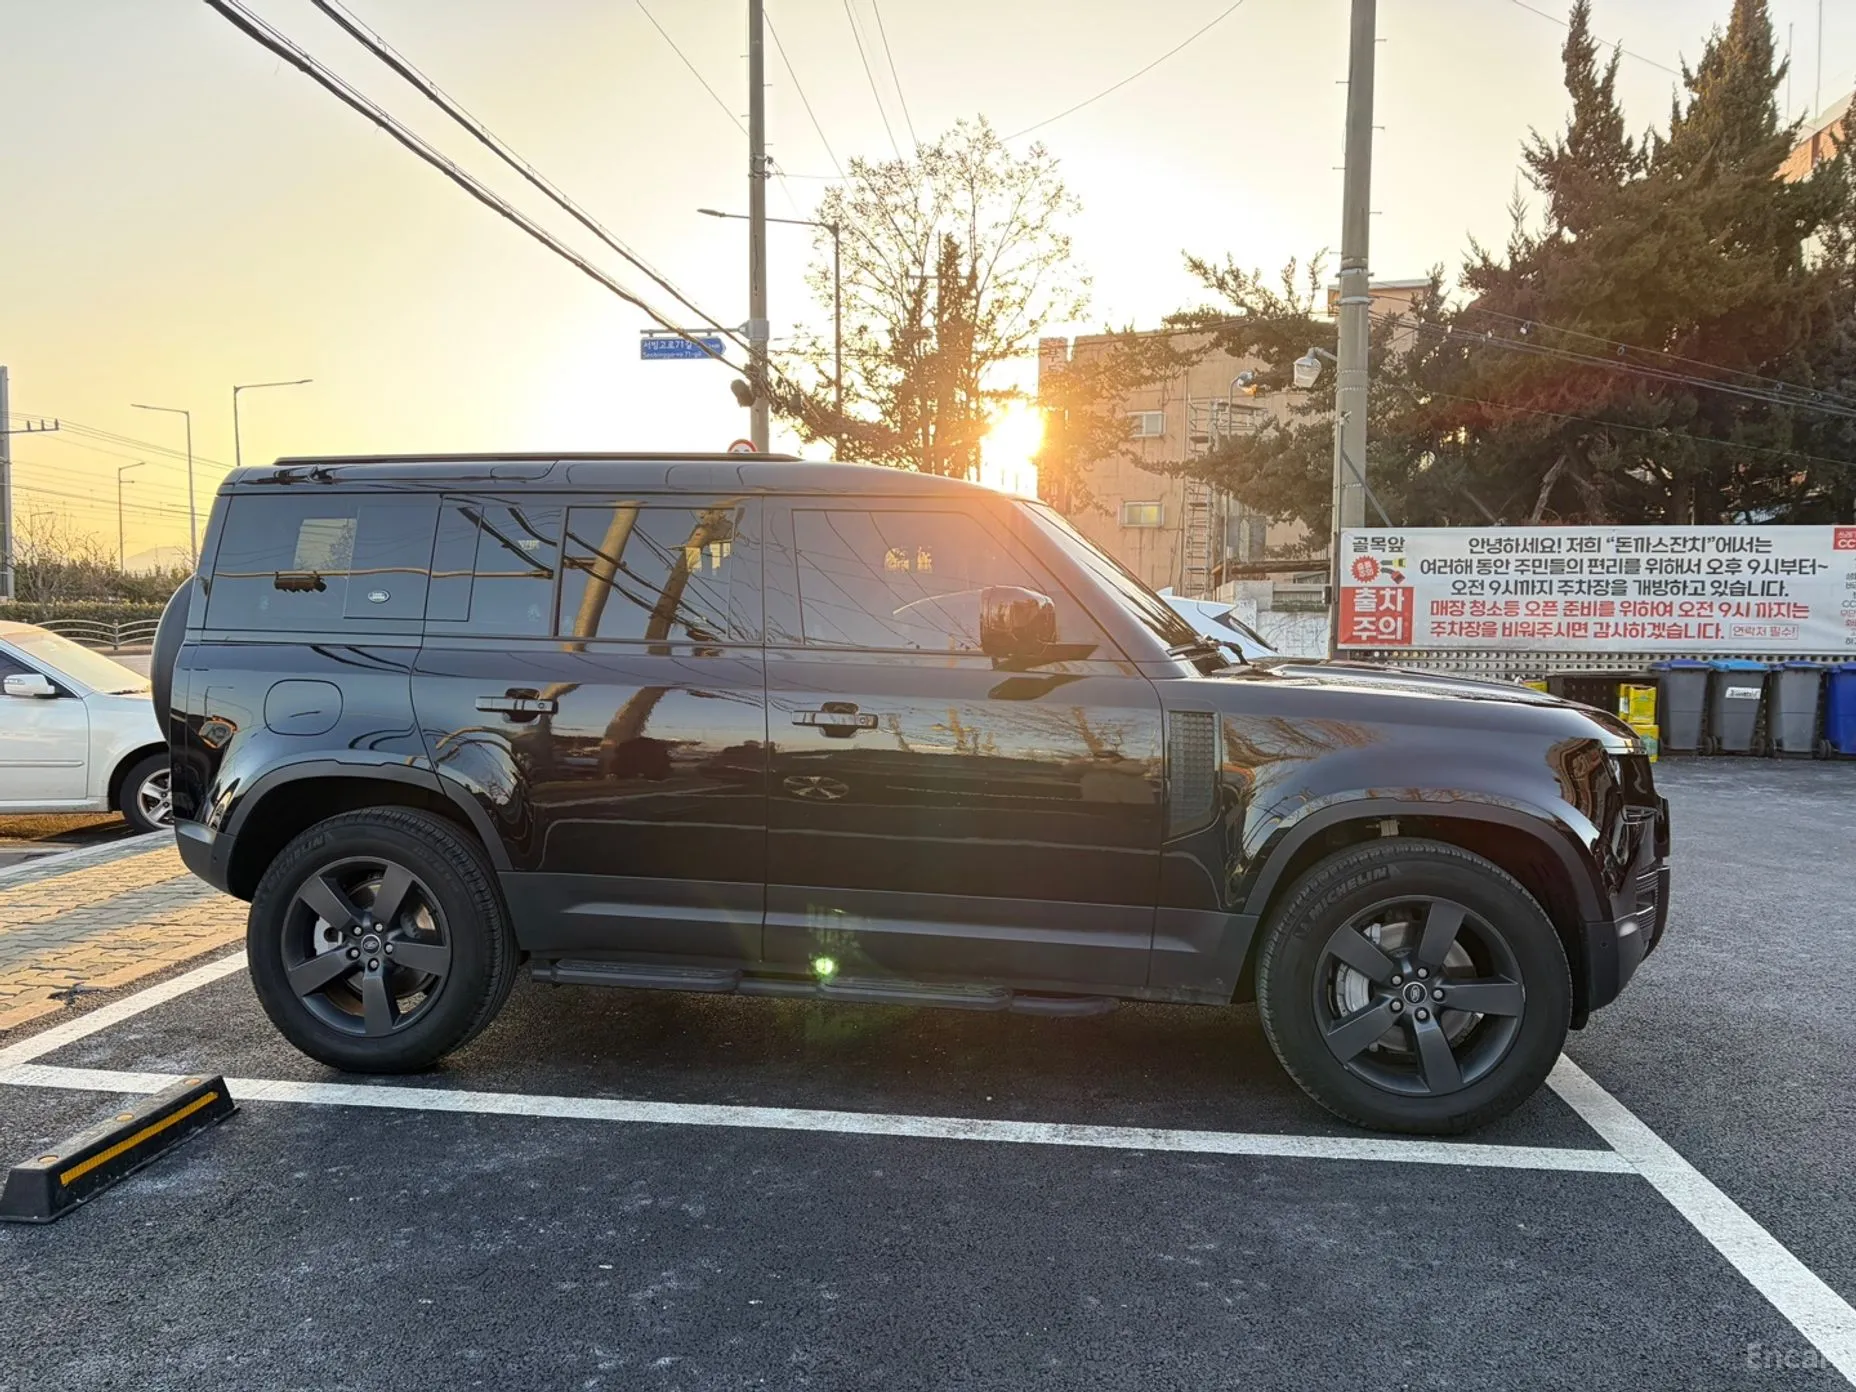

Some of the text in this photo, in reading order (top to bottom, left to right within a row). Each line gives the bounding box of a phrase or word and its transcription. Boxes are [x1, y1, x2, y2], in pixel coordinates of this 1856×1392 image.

[1352, 536, 1406, 553] 골목앞
[1469, 537, 1561, 554] 안녕하세요!
[1566, 537, 1601, 554] 저희
[1420, 558, 1829, 575] 여러해 동안 주민들의 편리를 위해서 오후 9시부터~
[1451, 580, 1789, 597] 오전 9시까지 주차장을 개방하고 있습니다.
[1353, 588, 1405, 612] 출차
[1430, 600, 1810, 619] 매장 청소등 오픈 준비를 위하여 오전 9시 까지는
[1352, 616, 1403, 640] 주의
[1430, 621, 1725, 639] 주차장을 비워주시면 감사하겠습니다.
[1308, 866, 1388, 921] MICHELIN
